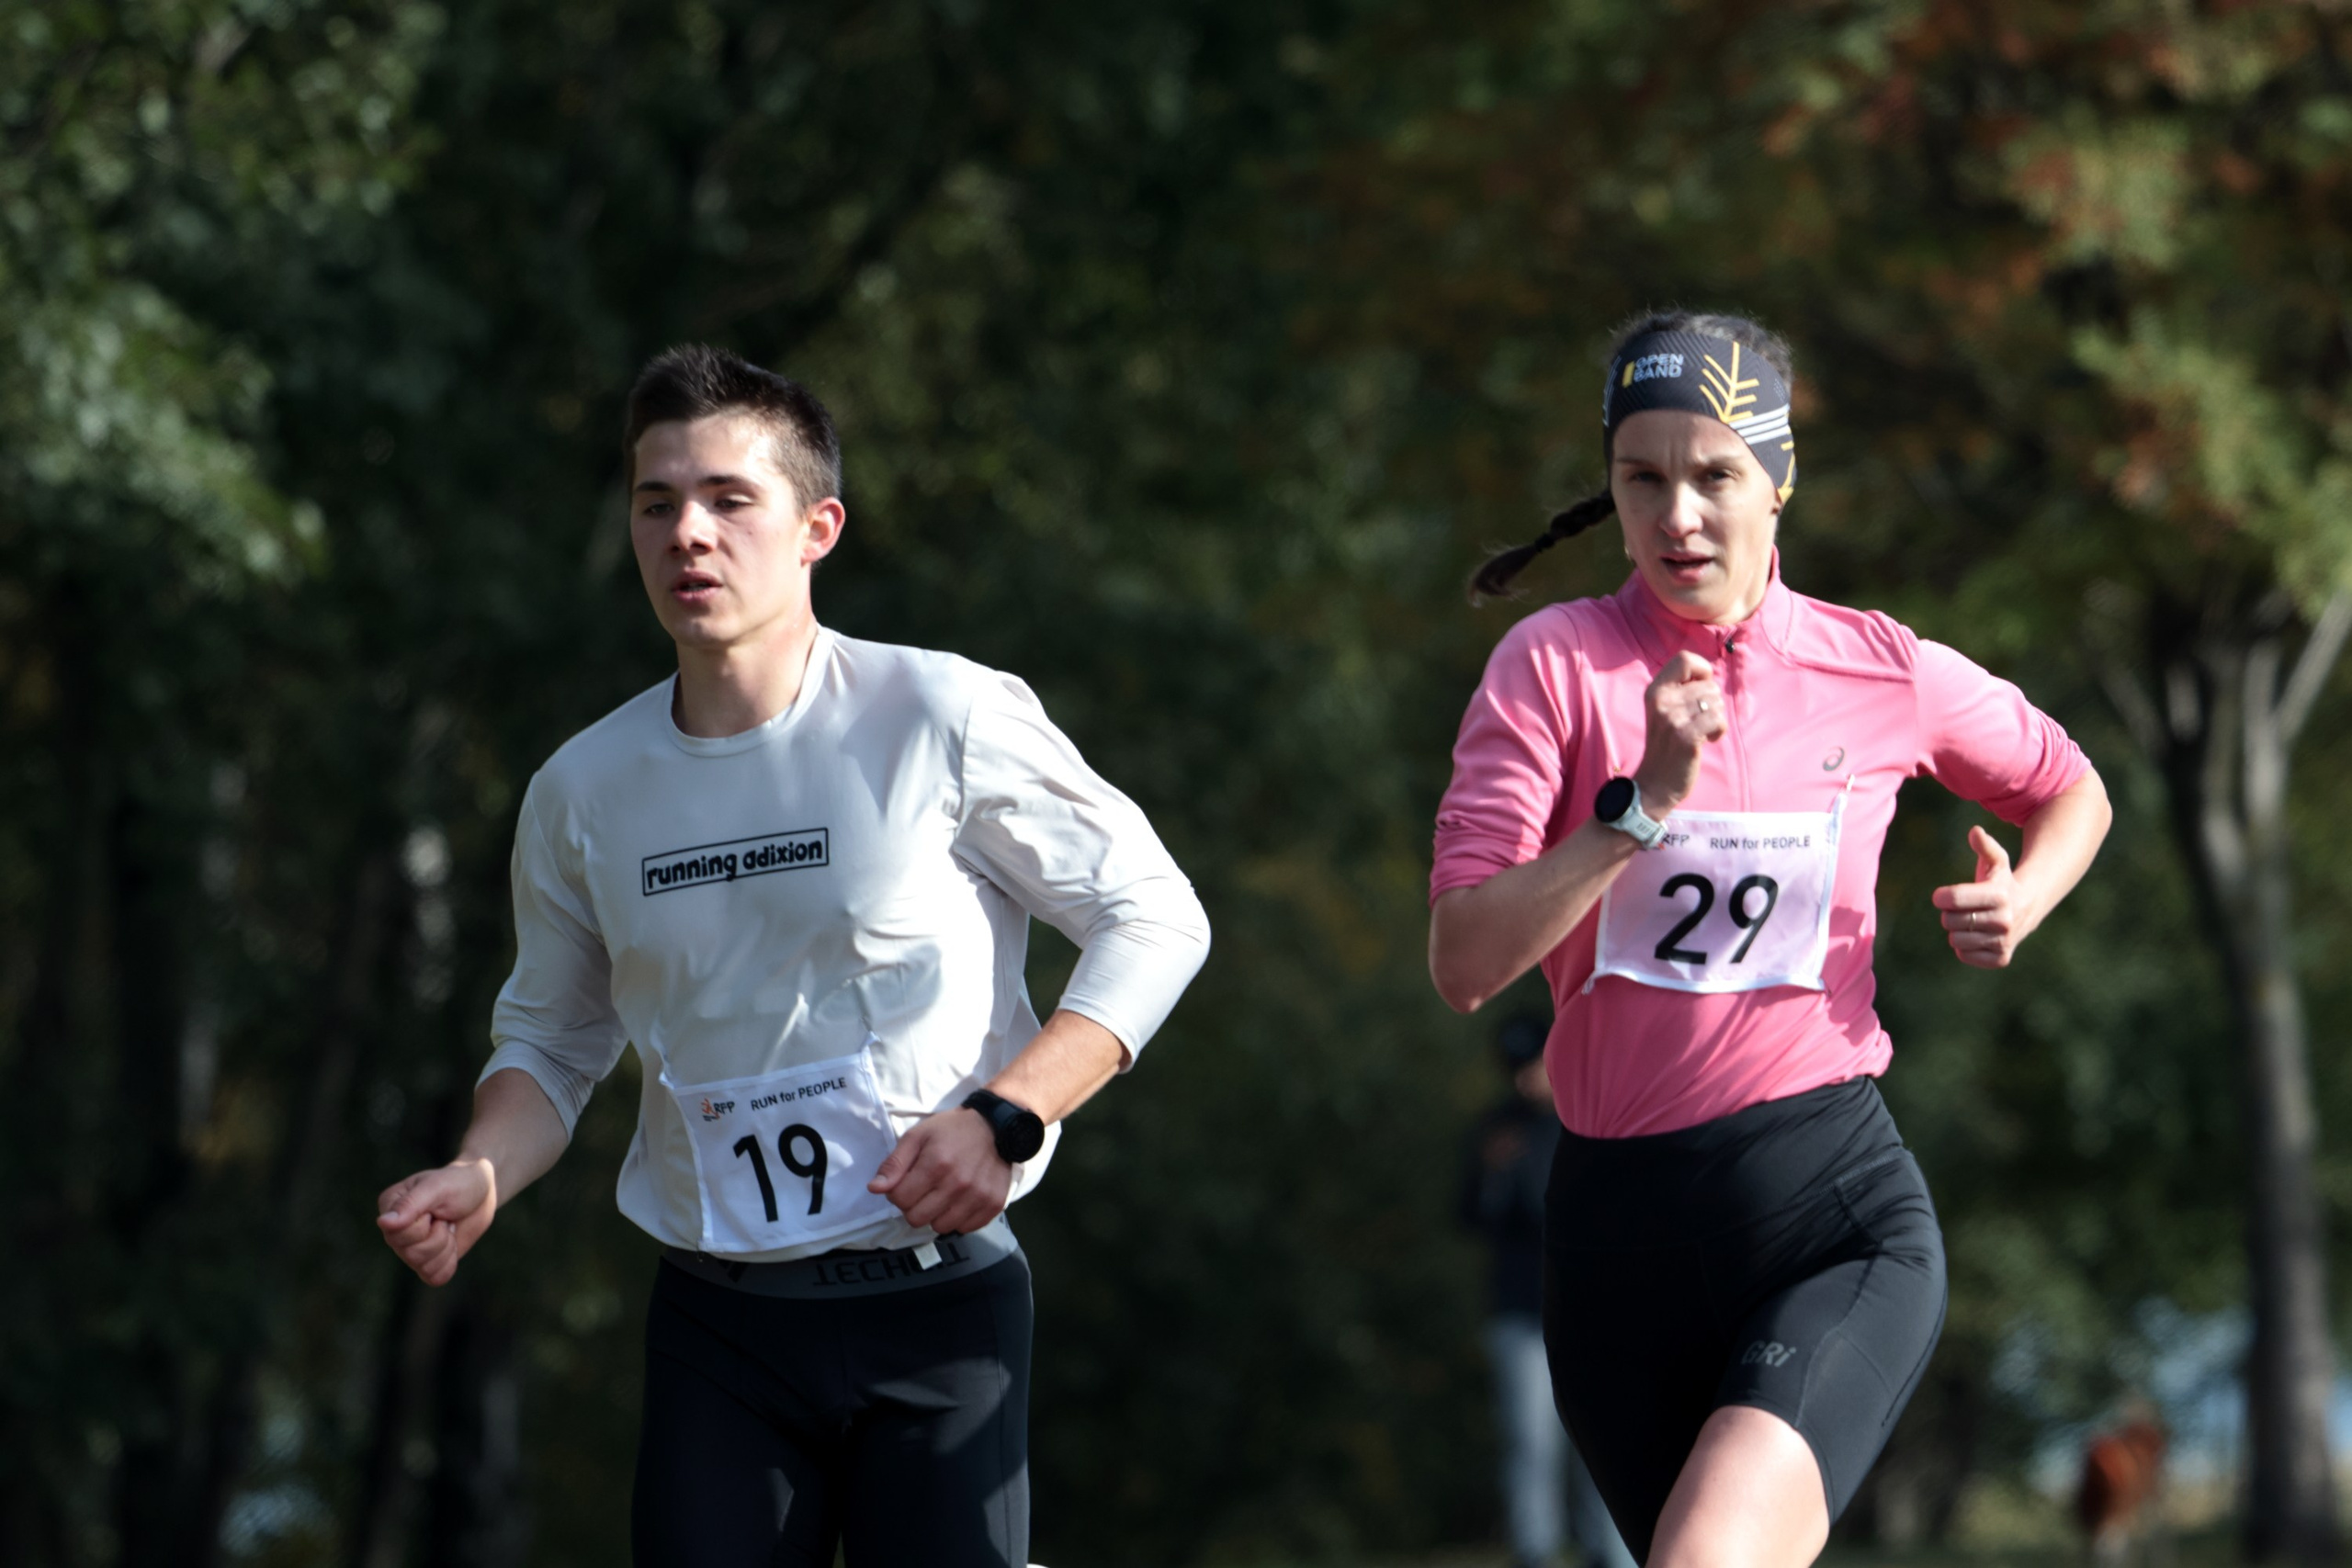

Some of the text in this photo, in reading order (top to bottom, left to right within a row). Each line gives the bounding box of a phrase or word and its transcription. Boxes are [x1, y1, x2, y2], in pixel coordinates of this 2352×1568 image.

[1633, 364, 1682, 383] BAND
[1635, 353, 1684, 368] OPEN
[1710, 836, 1738, 850] RUN
[1743, 836, 1758, 850] for
[1763, 834, 1811, 849] PEOPLE
[646, 840, 823, 889] running adixion
[1654, 872, 1779, 965] 29
[714, 1077, 847, 1115] RFP RUN for PEOPLE
[732, 1122, 828, 1224] 19
